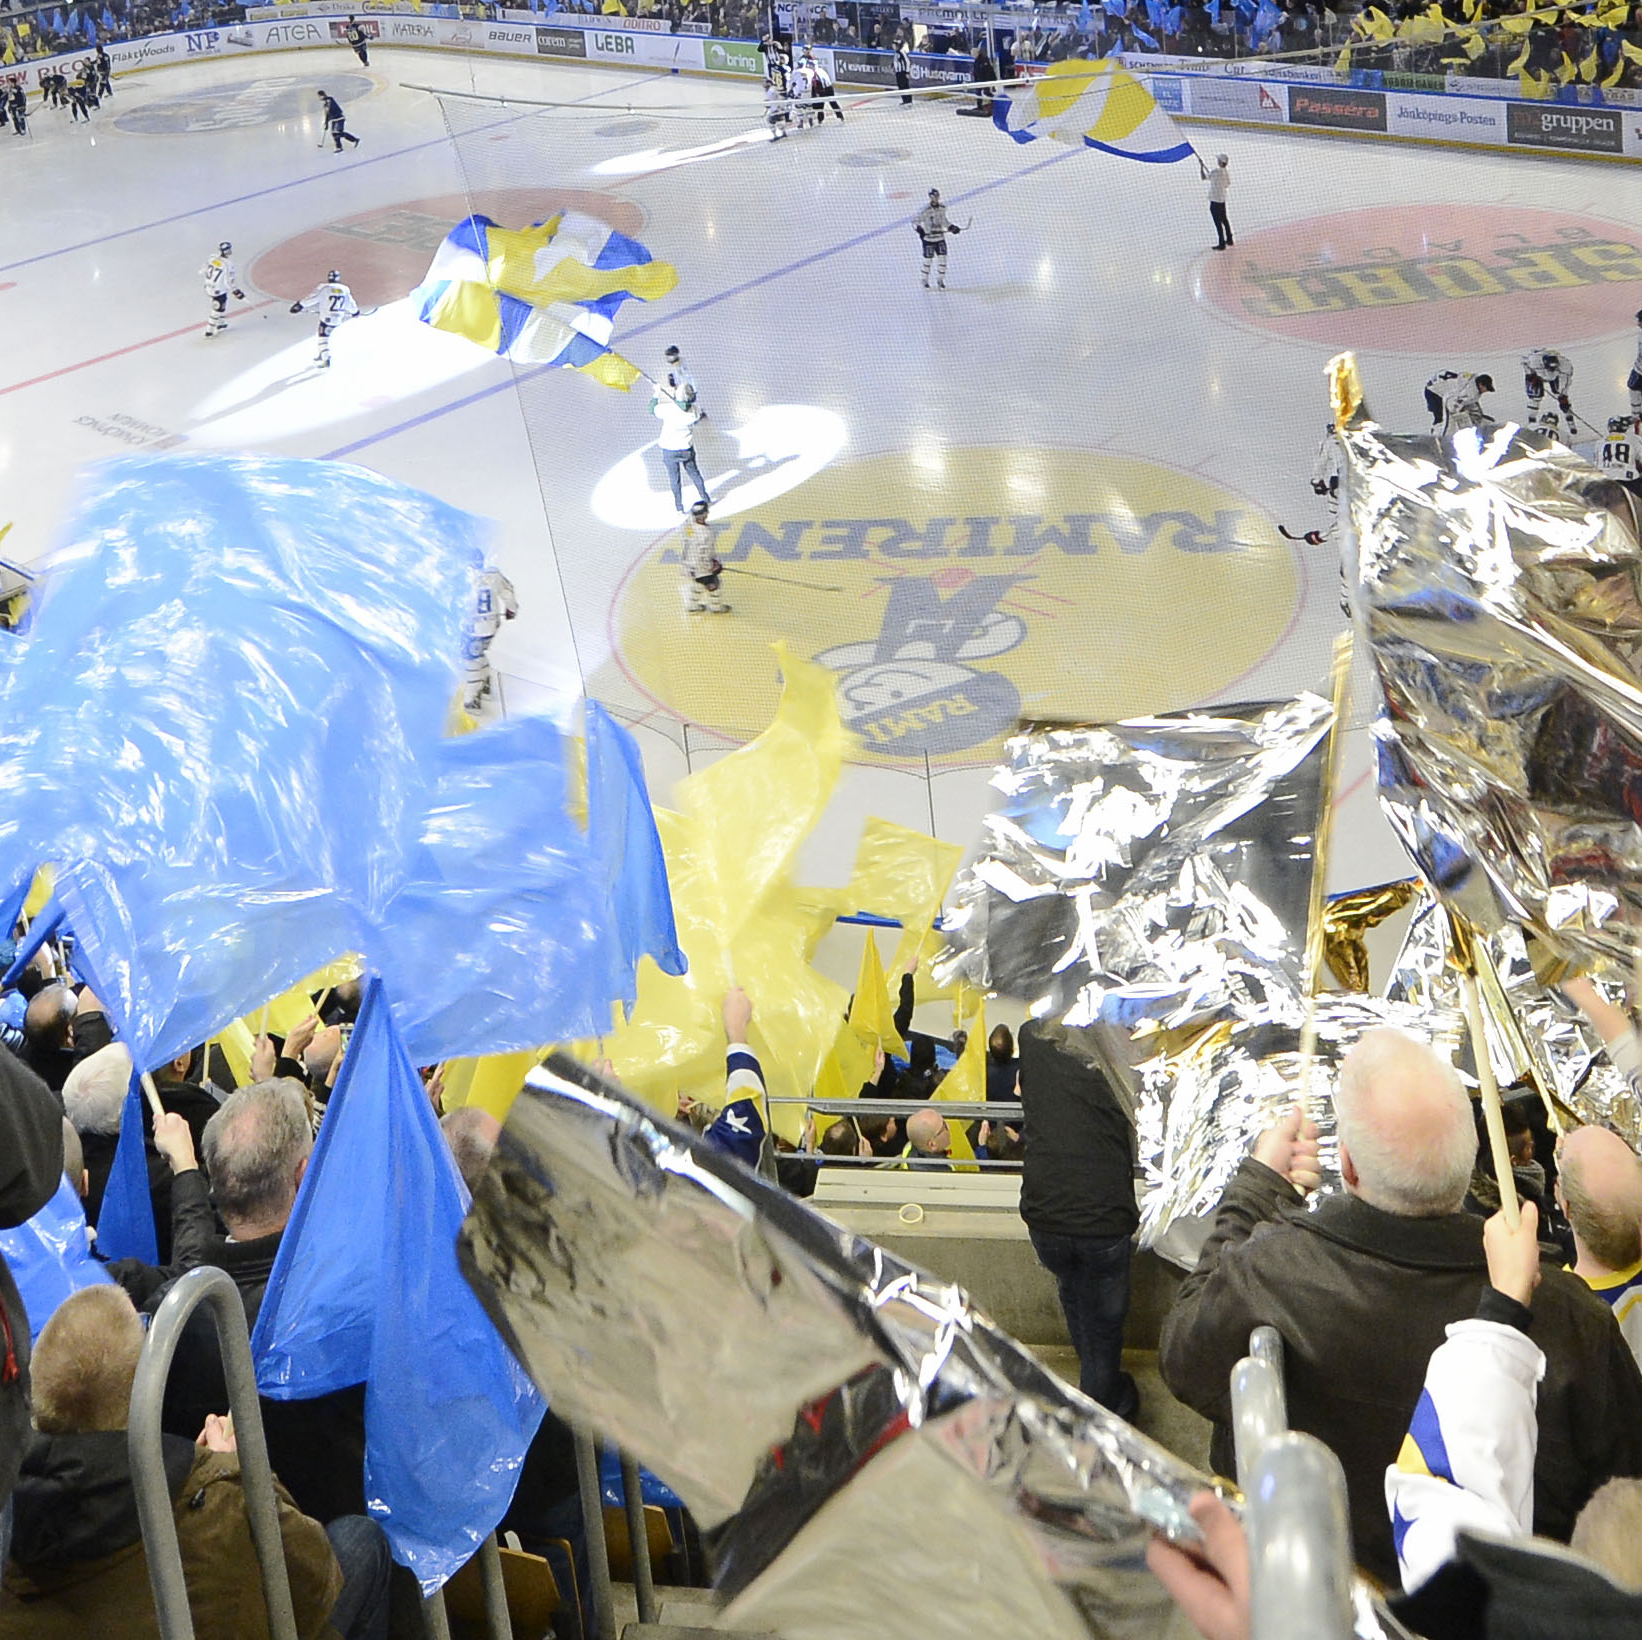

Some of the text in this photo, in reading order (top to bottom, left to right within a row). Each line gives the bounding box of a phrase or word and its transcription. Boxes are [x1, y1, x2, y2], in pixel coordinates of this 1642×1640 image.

[489, 30, 532, 43] BAUER
[595, 33, 636, 54] LEBA
[725, 51, 757, 72] bring
[919, 65, 973, 83] Husqvarna
[1602, 443, 1631, 464] 48
[864, 690, 980, 743] RAMI
